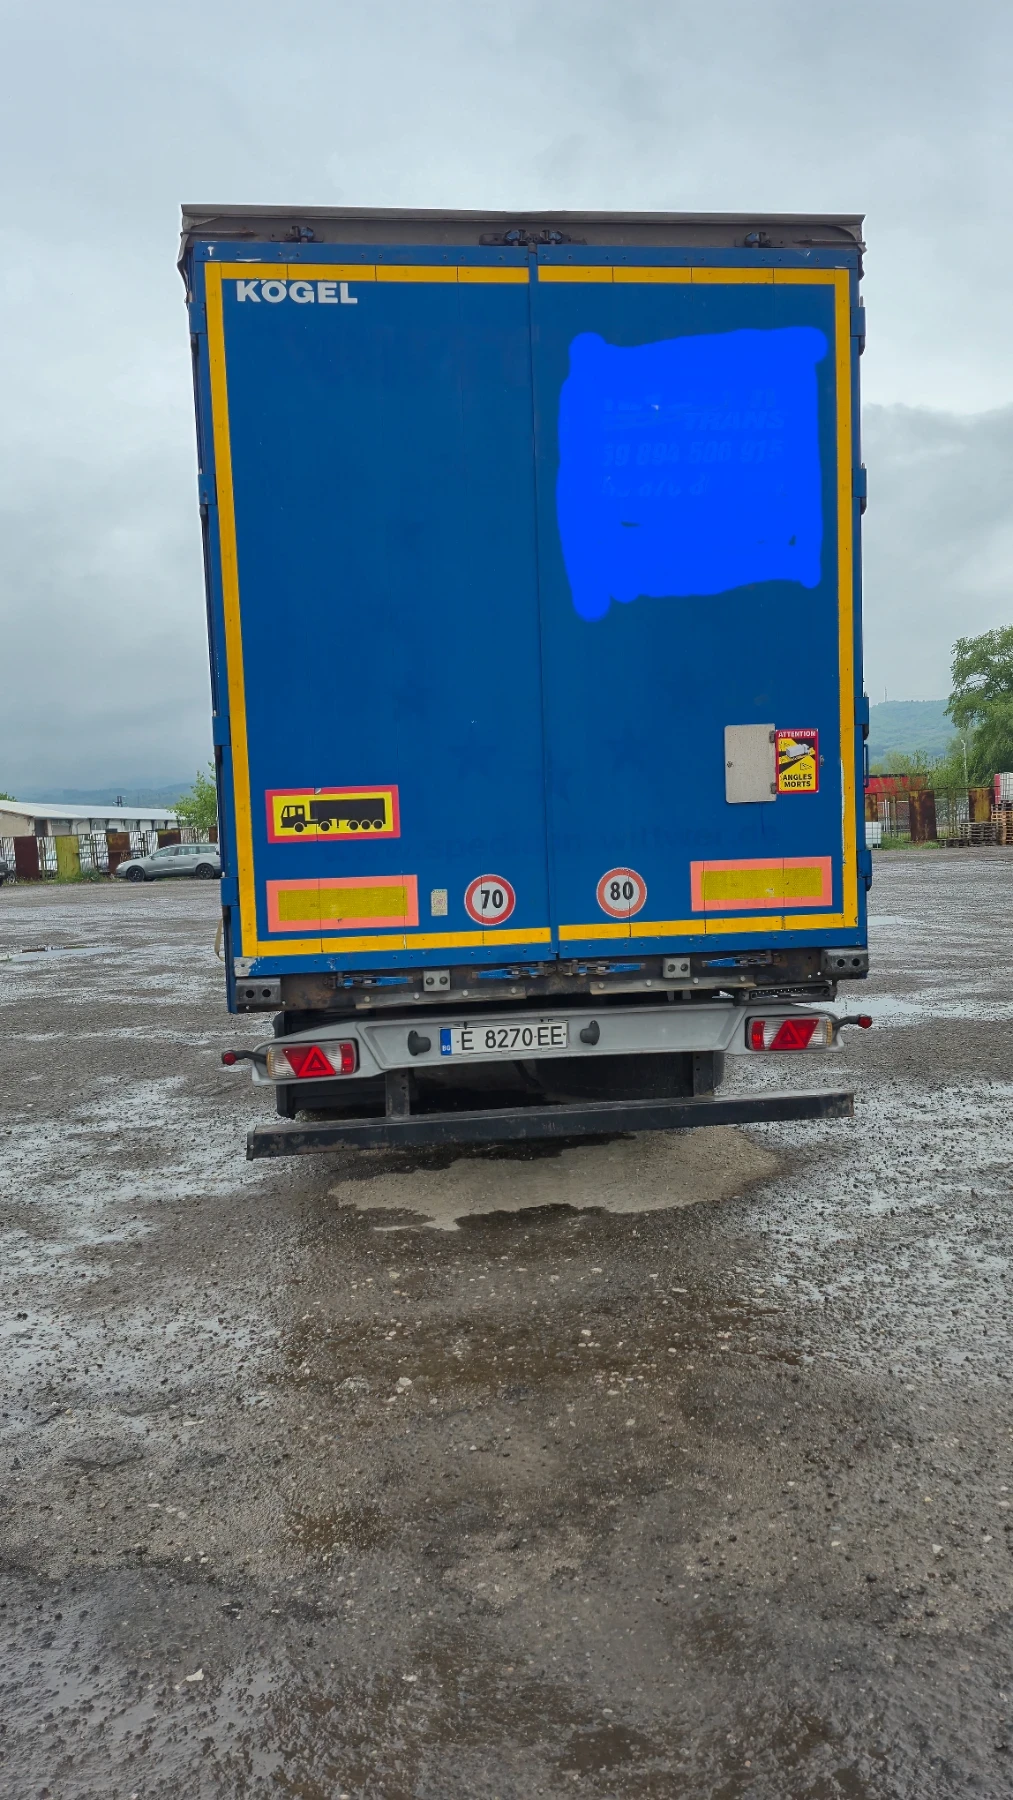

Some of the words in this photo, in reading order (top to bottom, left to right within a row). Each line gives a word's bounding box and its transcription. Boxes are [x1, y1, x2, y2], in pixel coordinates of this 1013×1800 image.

[236, 280, 358, 304] KÖGEL
[481, 889, 504, 910] 70
[610, 880, 634, 901] 80
[442, 1044, 451, 1052] BG
[460, 1030, 475, 1051] E
[485, 1027, 534, 1049] 8270
[537, 1025, 564, 1046] EE
